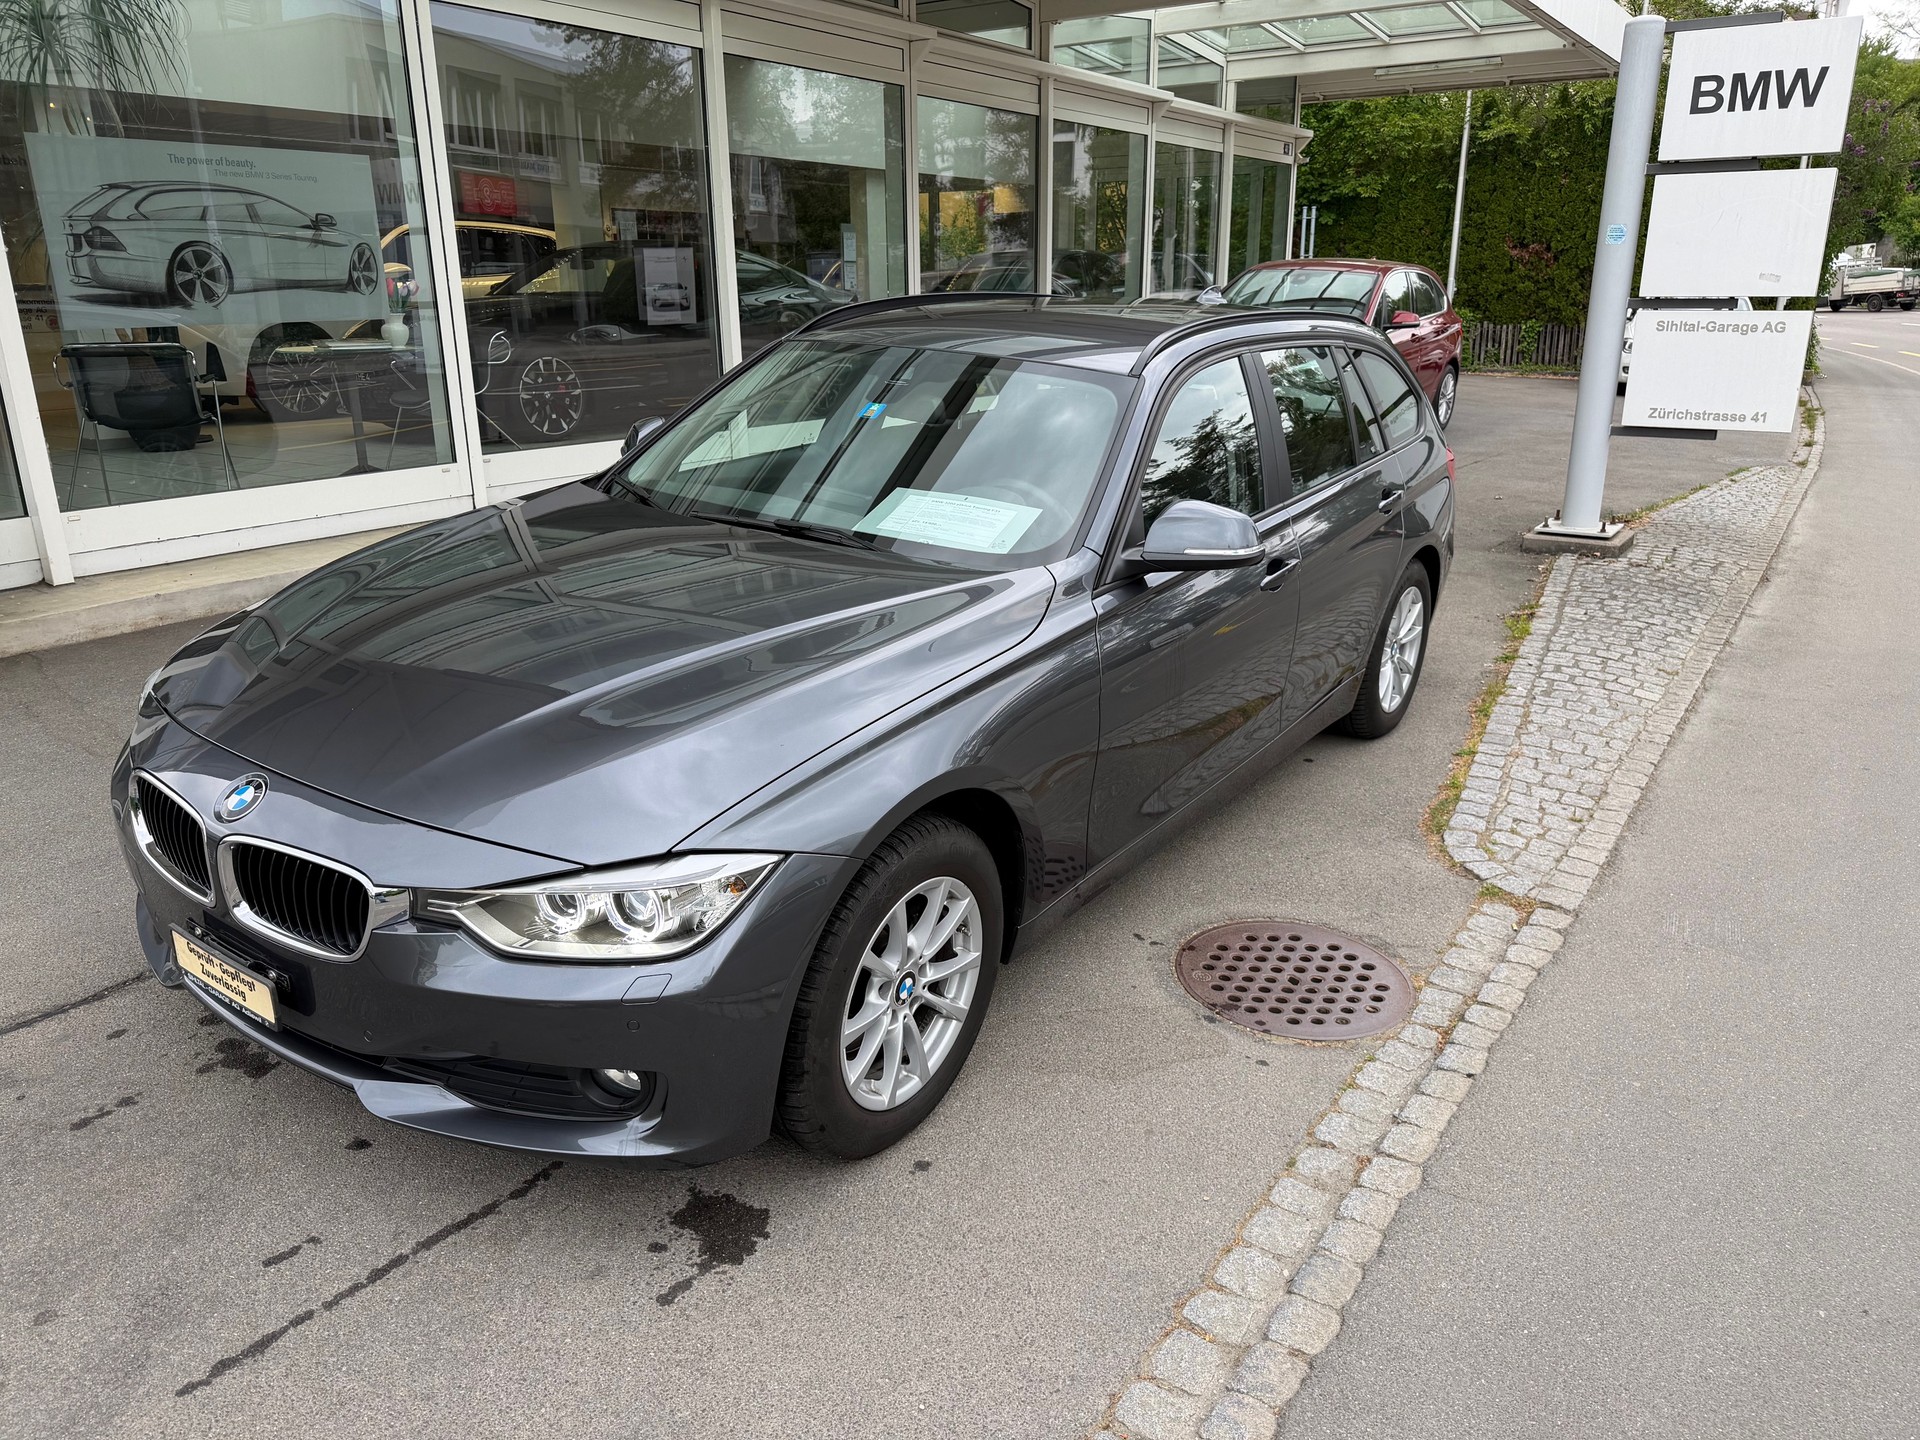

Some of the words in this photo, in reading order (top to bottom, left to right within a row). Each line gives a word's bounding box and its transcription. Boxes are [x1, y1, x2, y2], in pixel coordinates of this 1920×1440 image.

[1689, 66, 1830, 115] BMW
[167, 153, 185, 164] The
[187, 157, 214, 166] power
[215, 157, 224, 167] of
[225, 158, 256, 169] beauty.
[214, 169, 228, 177] The
[271, 173, 293, 181] Series
[1656, 320, 1758, 335] Sihltal-Garage
[1762, 321, 1786, 333] AG
[1648, 407, 1746, 422] Zürichstrasse
[1751, 411, 1767, 423] 41
[200, 963, 247, 1002] Zuverlässig
[220, 962, 256, 992] Gepflegt
